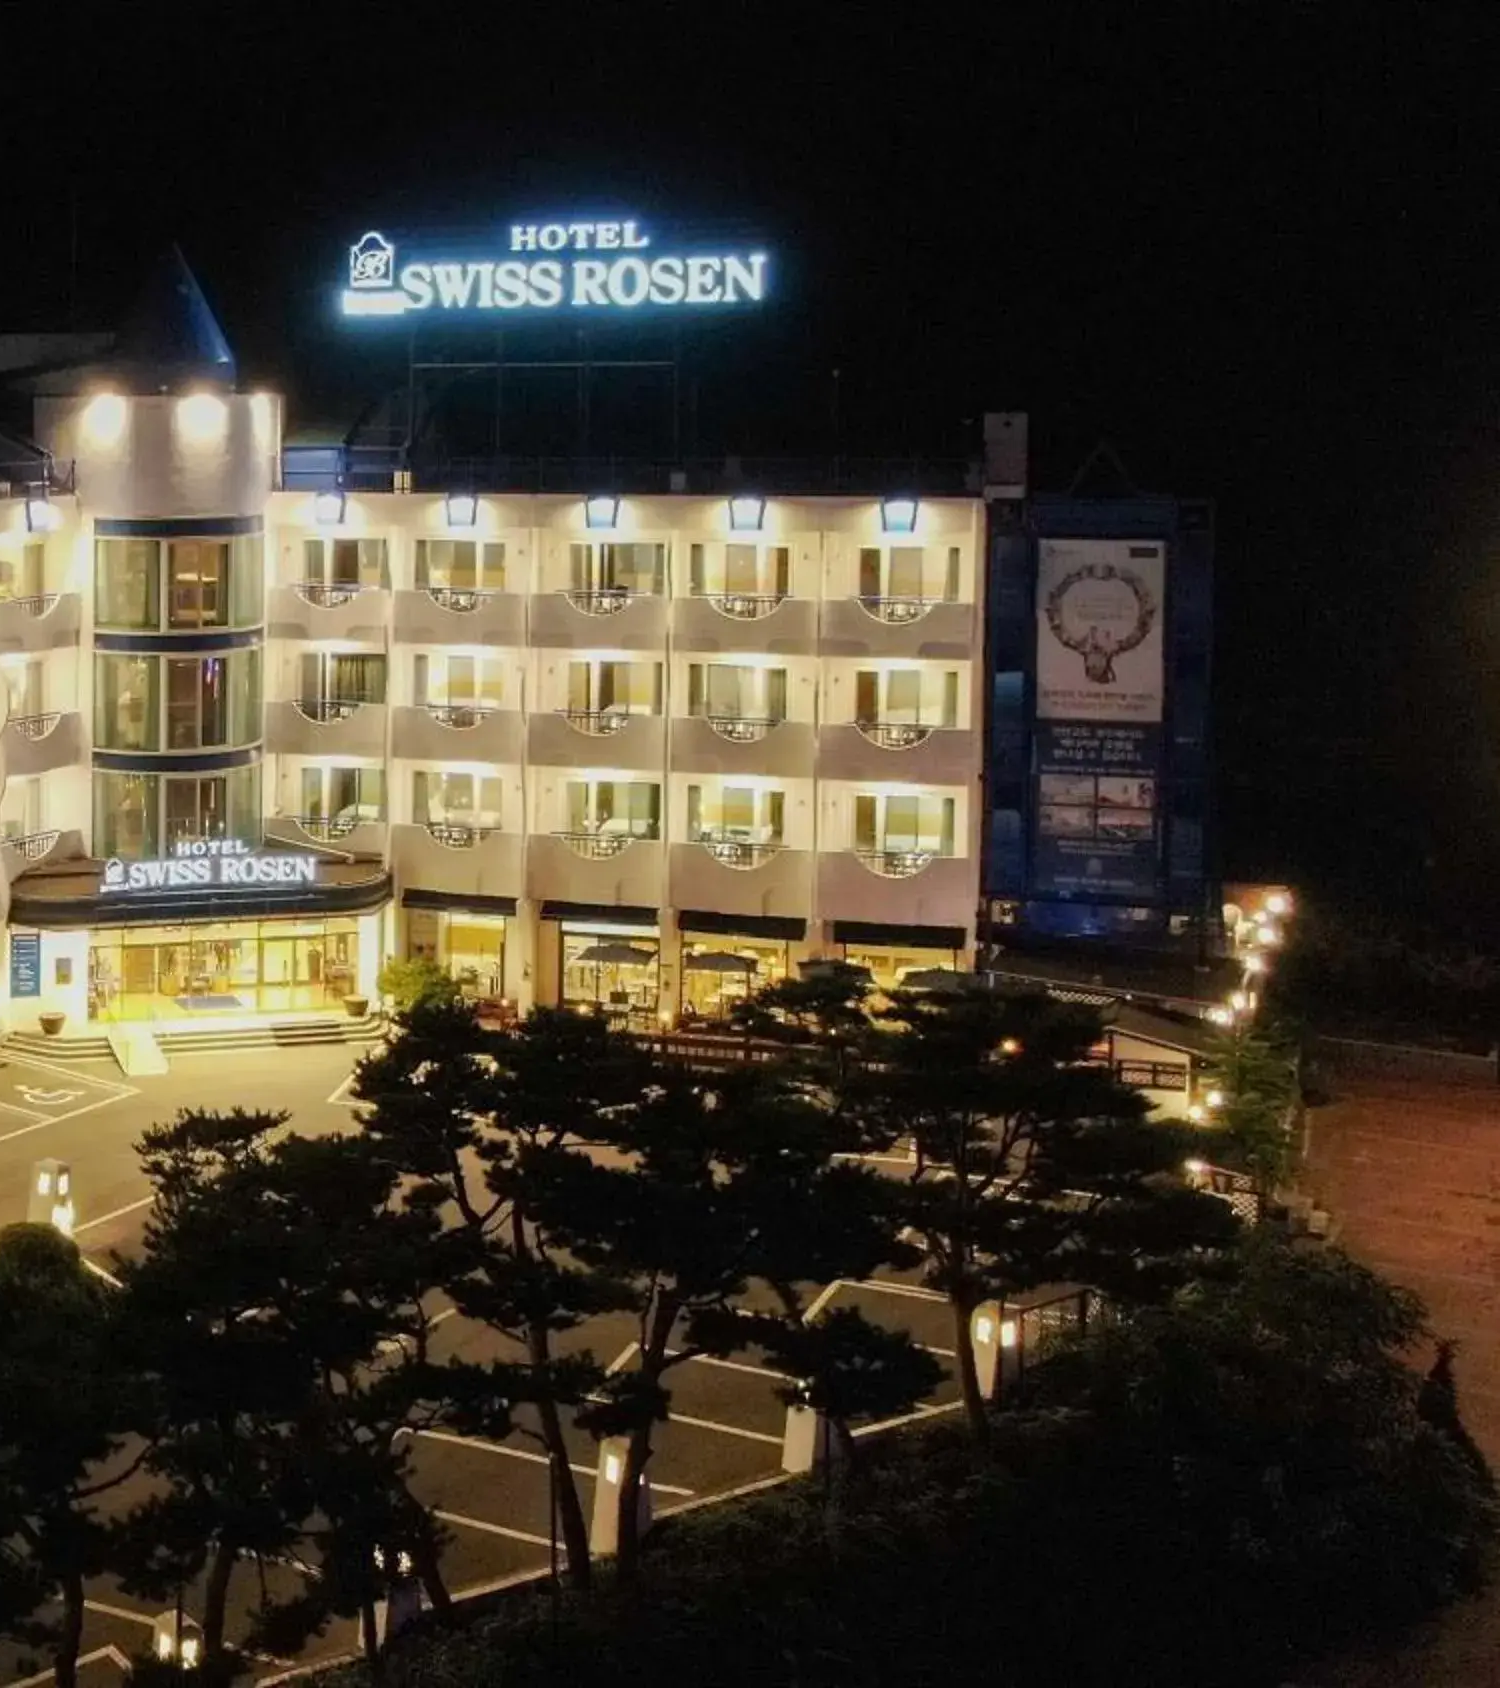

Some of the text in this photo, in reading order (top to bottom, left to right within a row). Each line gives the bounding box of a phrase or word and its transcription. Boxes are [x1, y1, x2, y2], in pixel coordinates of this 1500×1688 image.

[510, 221, 649, 251] HOTEL
[399, 260, 563, 314] SWISS
[571, 253, 767, 307] ROSEN
[176, 840, 250, 857] HOTEL
[128, 856, 317, 889] SWISS ROSEN
